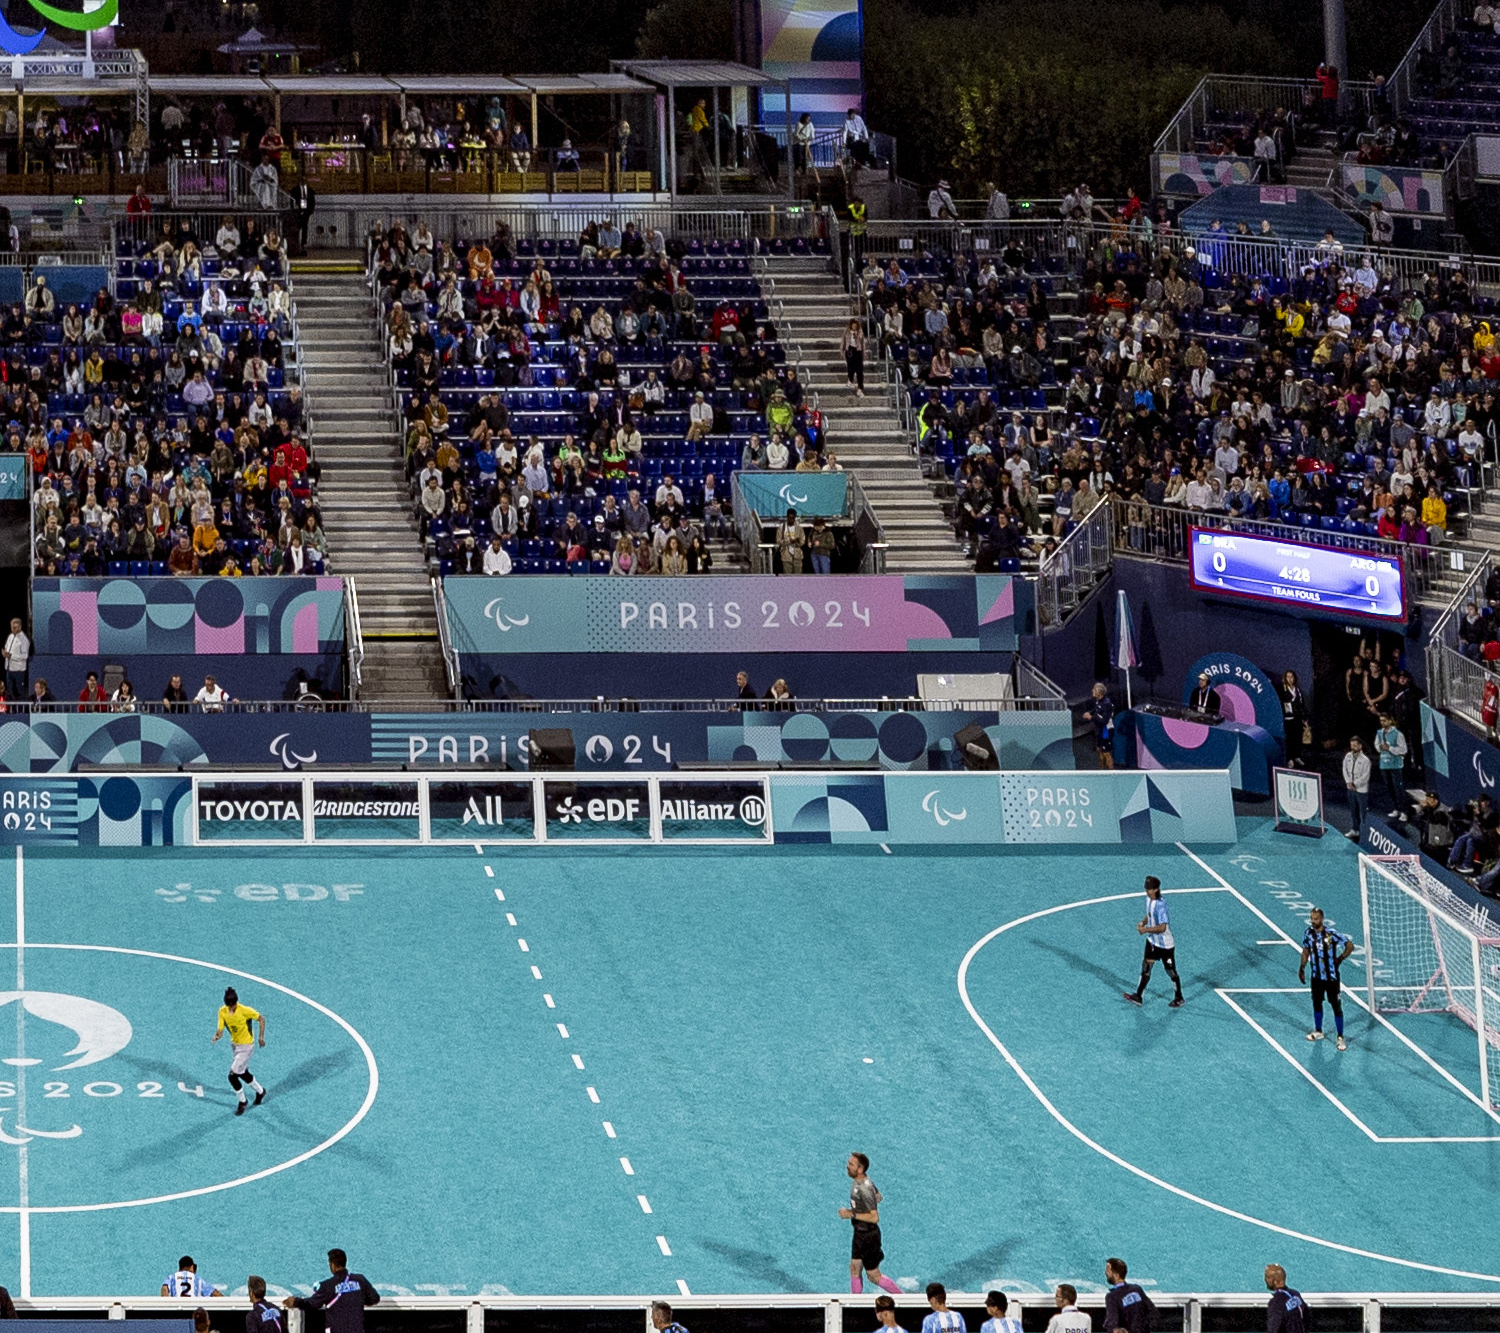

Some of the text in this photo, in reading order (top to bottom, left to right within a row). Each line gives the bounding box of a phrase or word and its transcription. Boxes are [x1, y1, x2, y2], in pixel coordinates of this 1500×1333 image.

[1213, 552, 1226, 572] 0
[1350, 559, 1375, 571] ARG
[1272, 586, 1320, 601] TEAM FOULS
[1365, 576, 1379, 596] 0
[761, 601, 870, 628] 2024
[1235, 666, 1263, 694] 2024
[585, 735, 671, 763] 024
[200, 801, 301, 821] TOYOTA
[313, 799, 420, 816] BRIDGESTONE
[661, 800, 735, 820] Allianz
[1029, 809, 1093, 827] 2024
[1367, 827, 1401, 855] TOYOTA
[44, 1081, 205, 1098] 2024
[180, 1283, 192, 1297] 2
